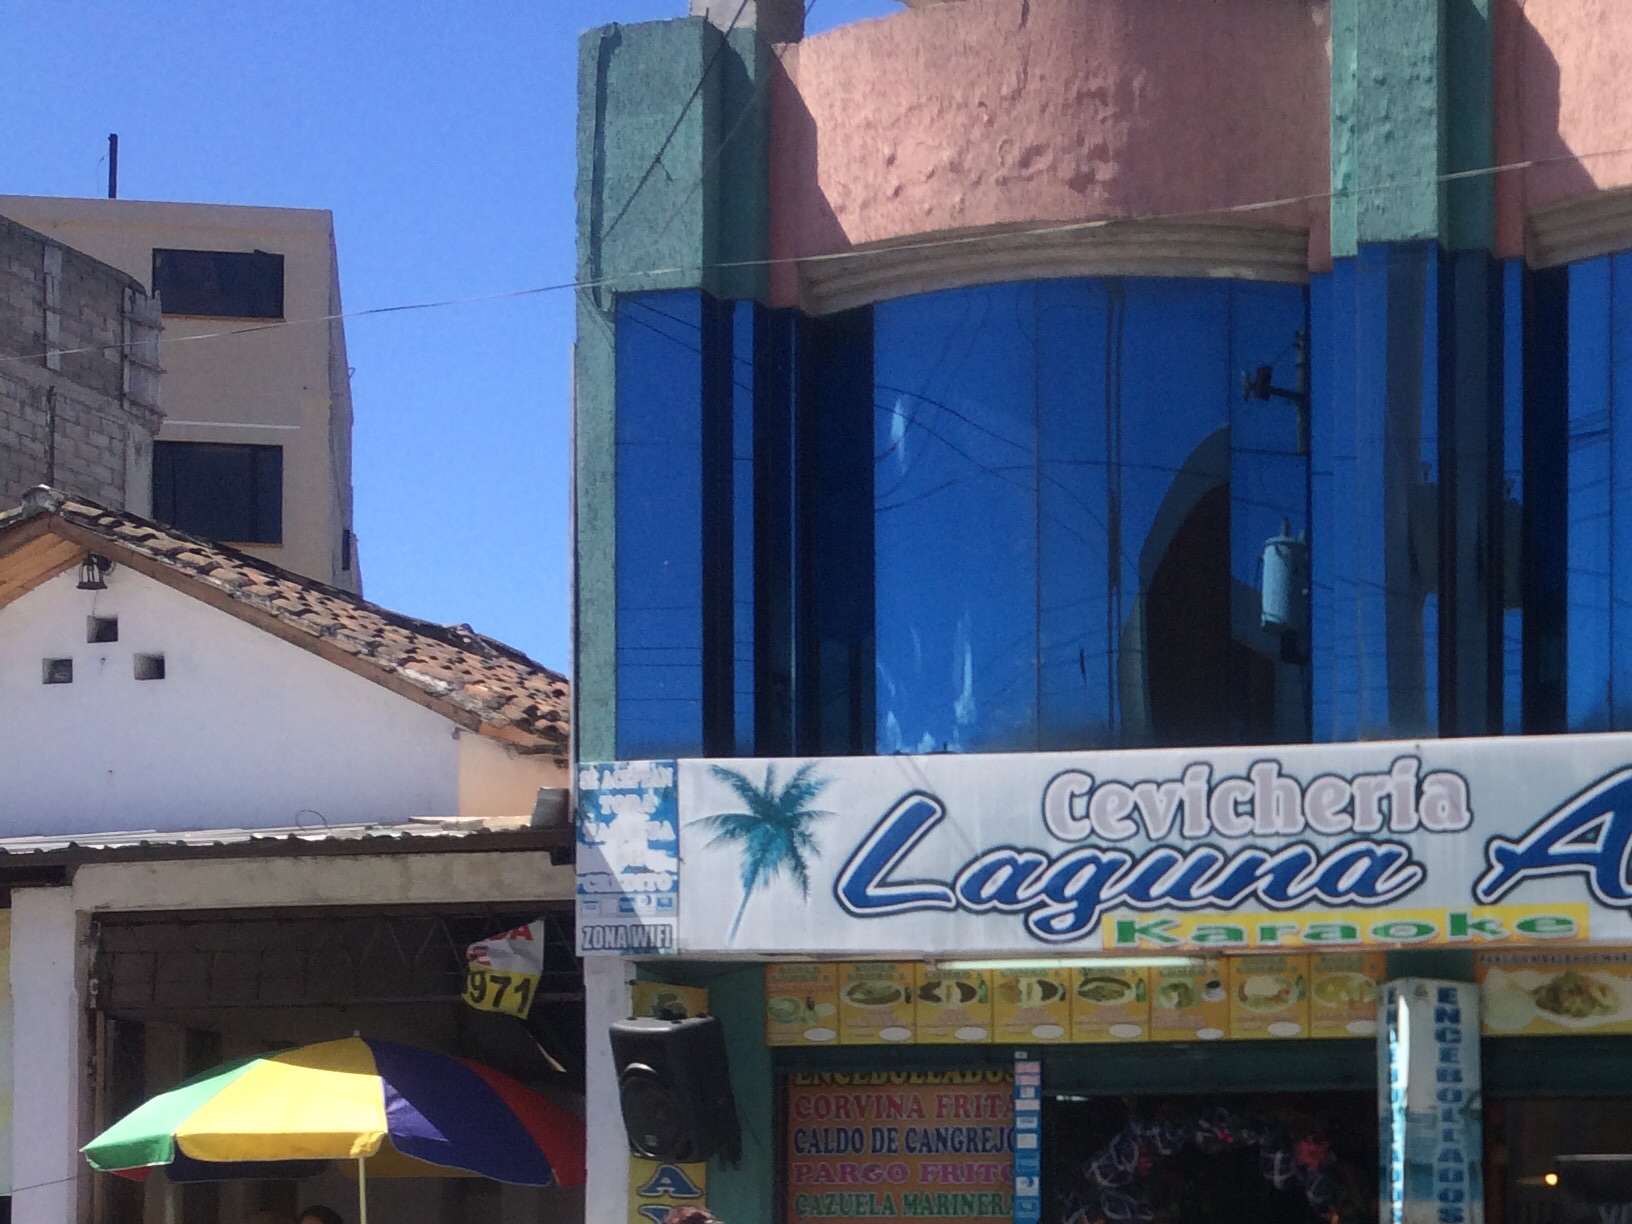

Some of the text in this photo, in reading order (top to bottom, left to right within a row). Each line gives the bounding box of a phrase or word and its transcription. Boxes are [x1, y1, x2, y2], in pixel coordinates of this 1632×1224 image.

[834, 789, 1427, 942] Laguna
[581, 924, 673, 950] ZONA WIFI
[1114, 909, 1580, 947] Karaoke
[467, 967, 532, 1014] 971
[794, 1092, 926, 1120] CORVINA
[794, 1126, 865, 1154] CALDO
[871, 1126, 898, 1154] DE
[792, 1161, 910, 1184] PARGO
[794, 1192, 898, 1217] CAZUELA
